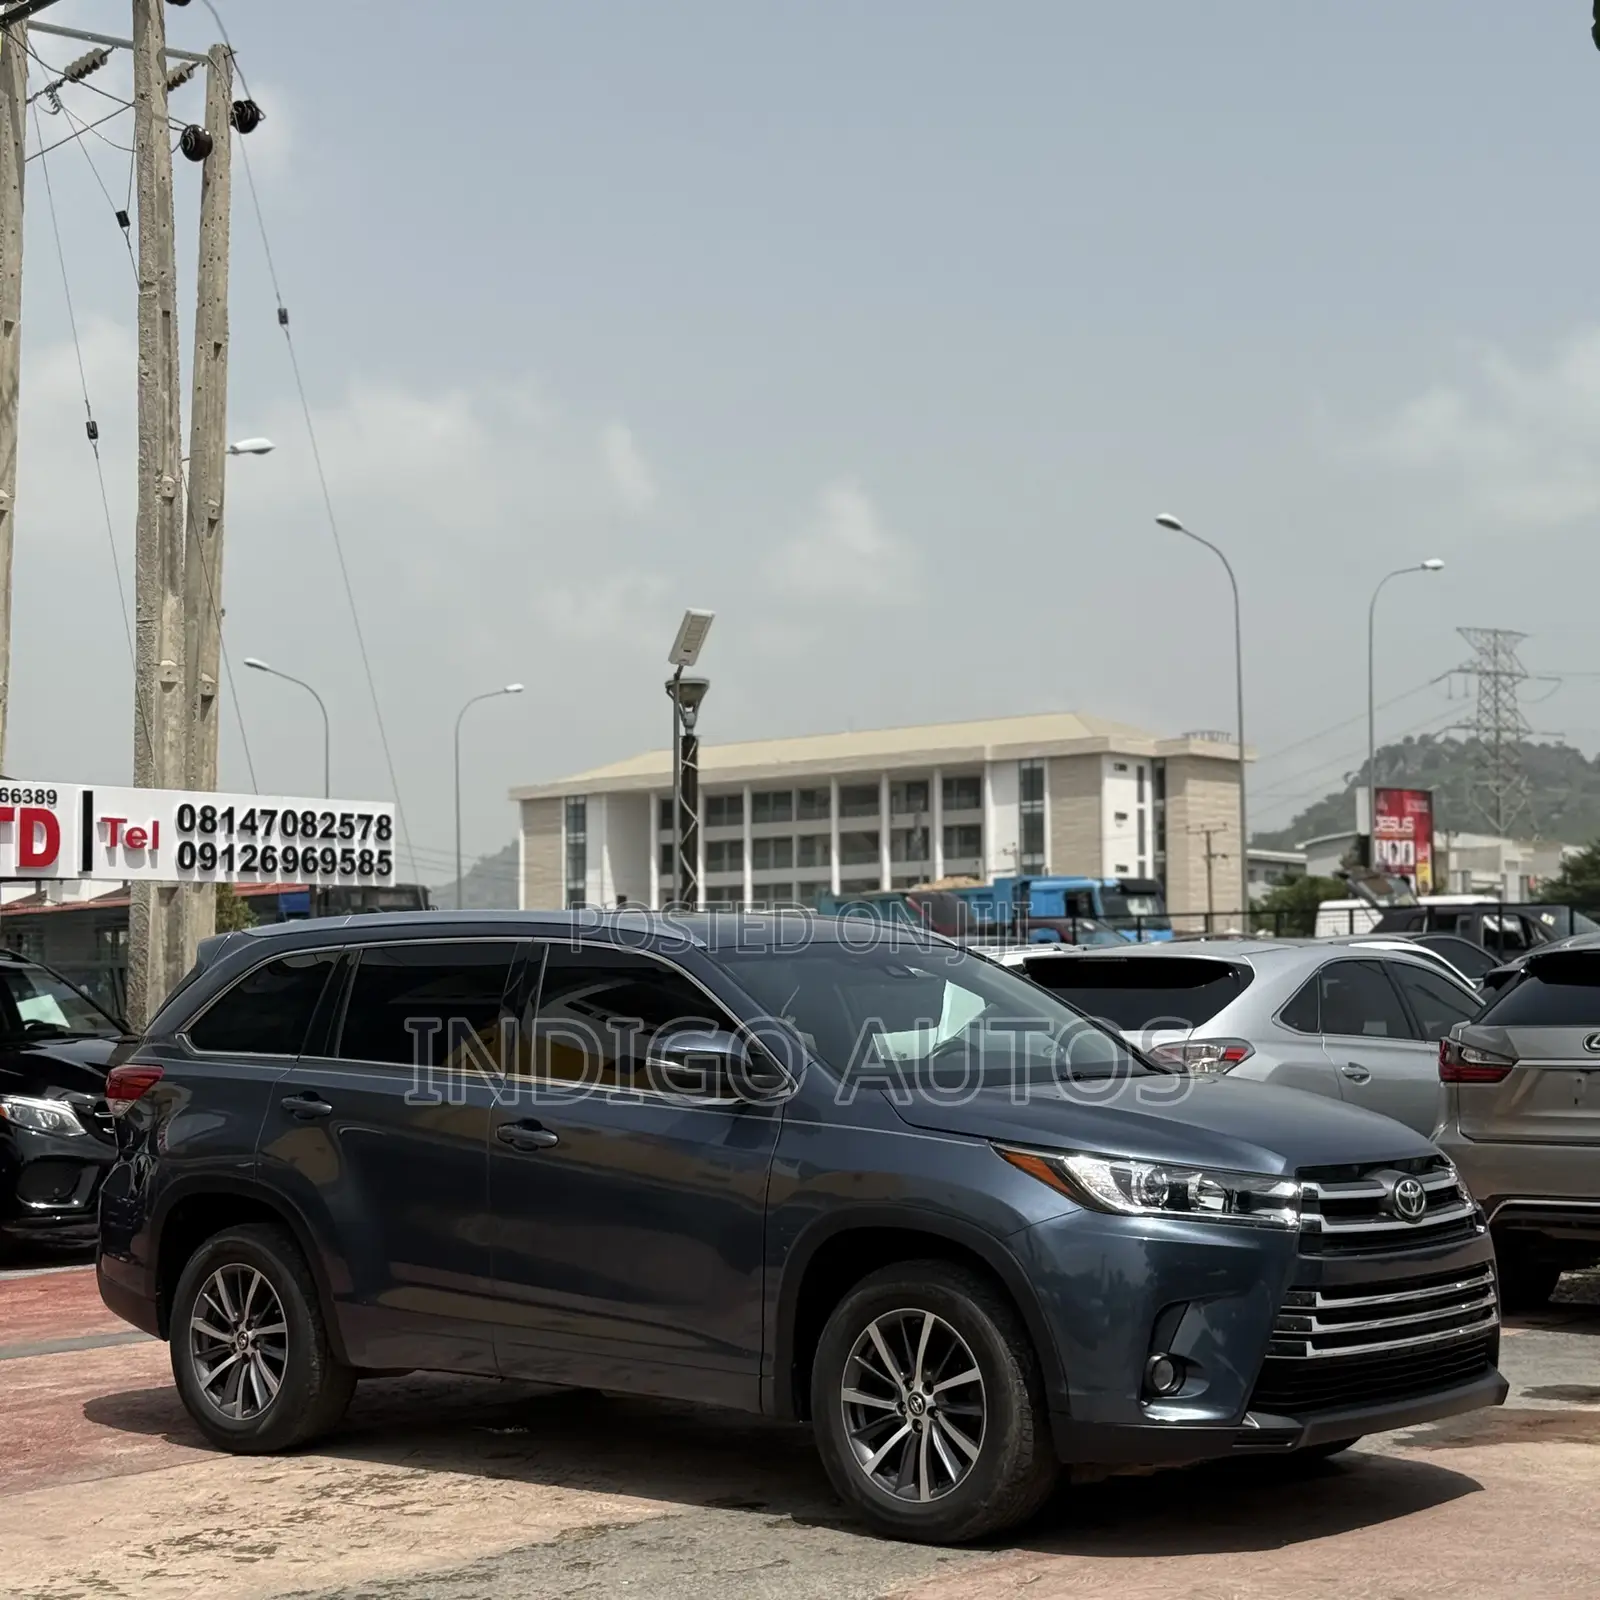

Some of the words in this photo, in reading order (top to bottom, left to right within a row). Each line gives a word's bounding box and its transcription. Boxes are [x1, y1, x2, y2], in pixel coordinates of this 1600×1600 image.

[100, 816, 160, 850] Tel
[177, 803, 392, 841] 08147082578
[177, 841, 393, 876] 09126969585
